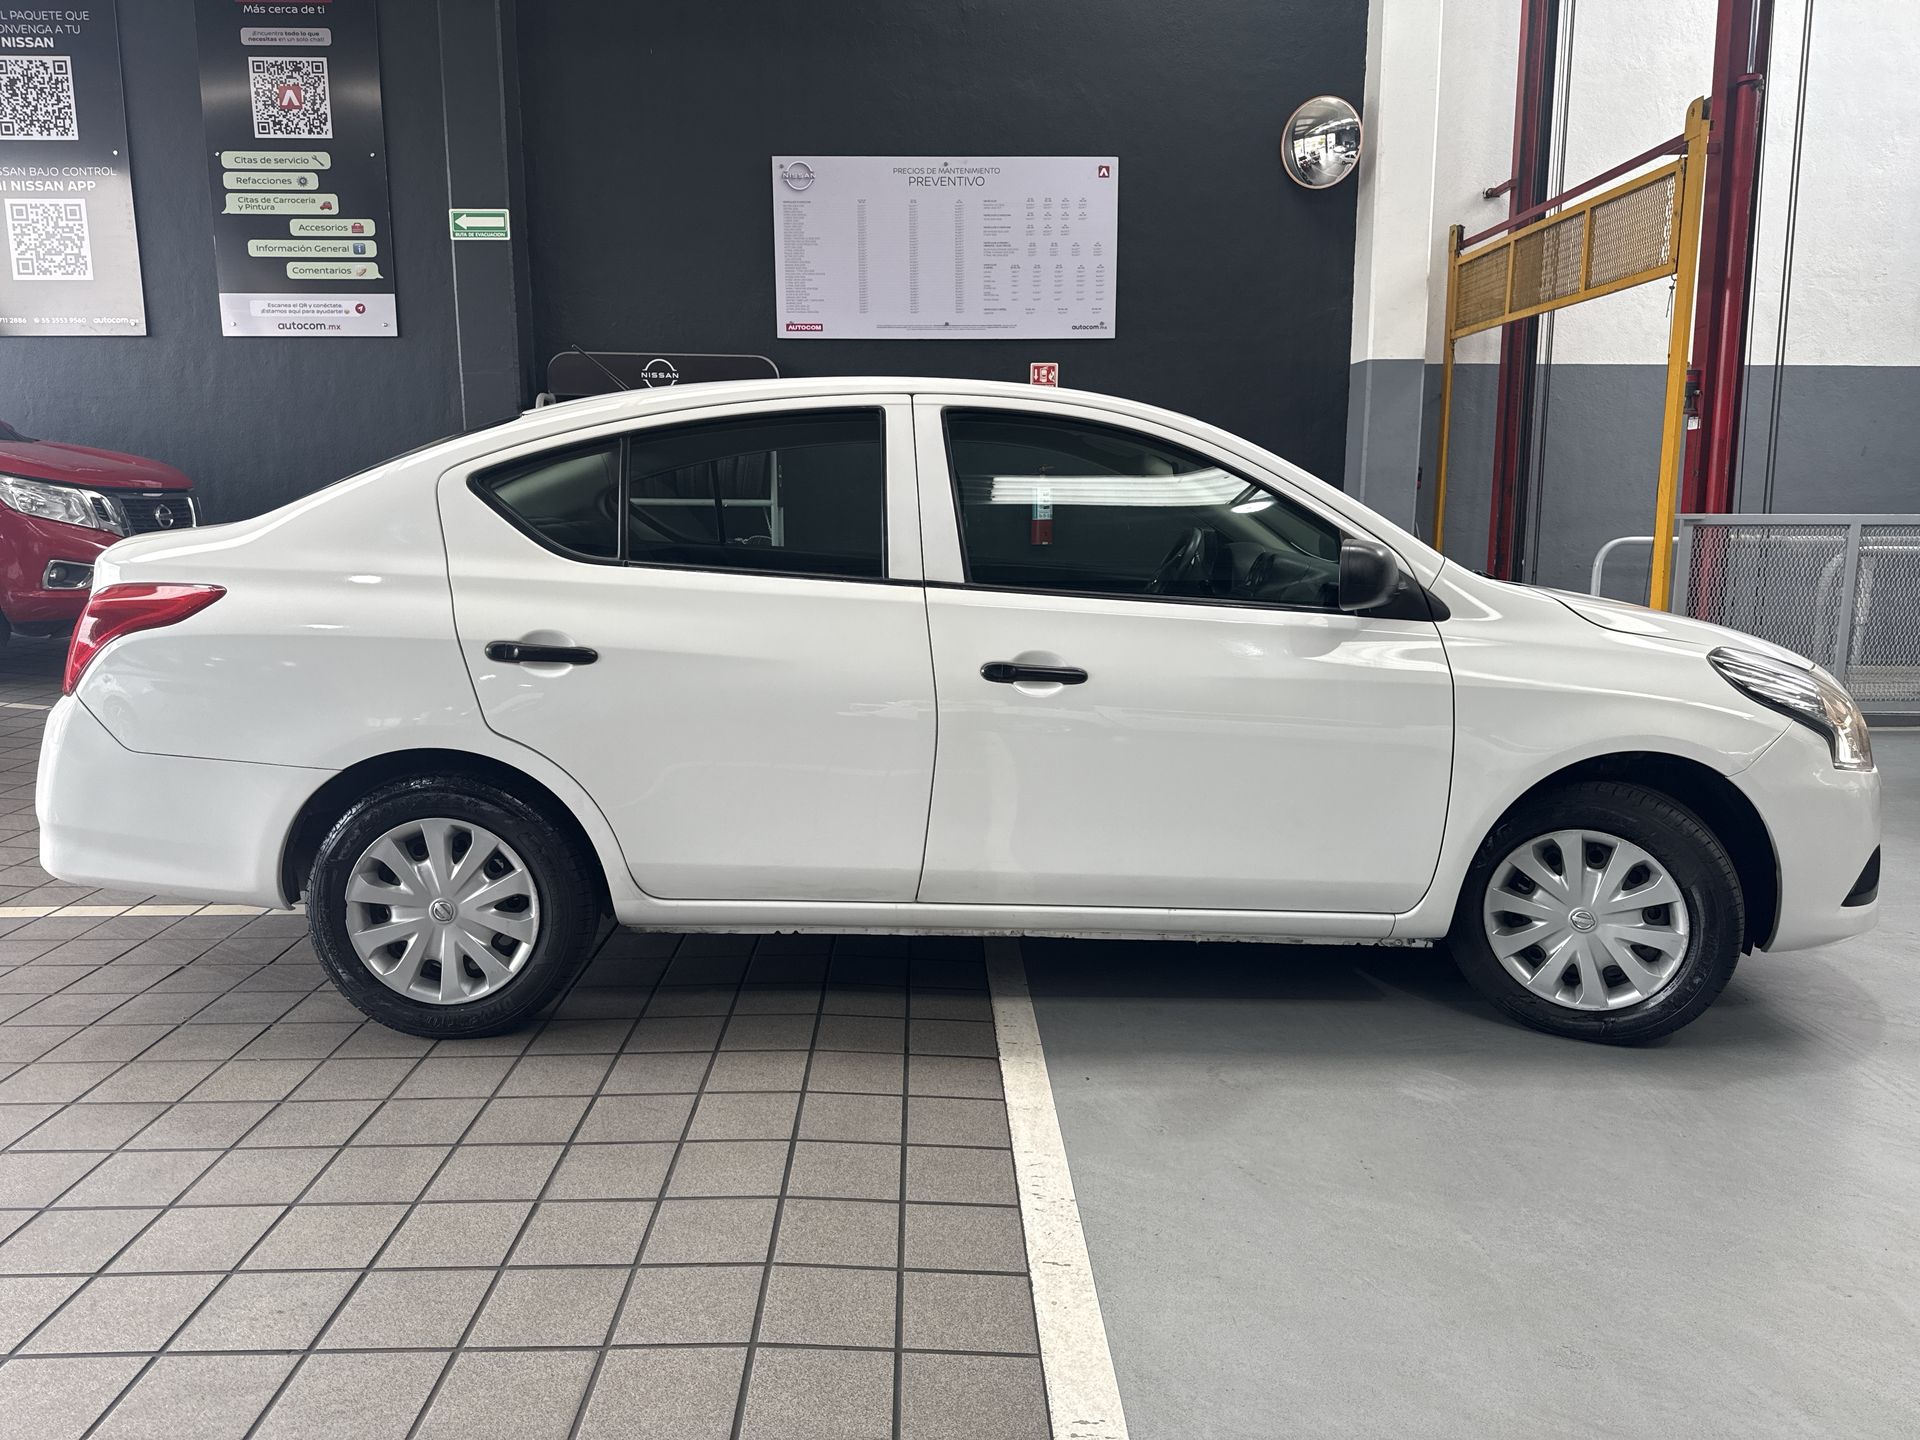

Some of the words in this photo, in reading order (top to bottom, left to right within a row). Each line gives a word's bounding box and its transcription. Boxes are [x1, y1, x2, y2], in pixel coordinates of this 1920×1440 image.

[243, 4, 266, 14] Más
[268, 6, 298, 14] cerca
[301, 5, 315, 14] de
[317, 5, 325, 14] ti
[10, 10, 62, 21] PAQUETE
[65, 10, 90, 21] QUE
[55, 24, 63, 34] A
[65, 24, 80, 34] TU
[1, 36, 54, 48] NISSAN
[234, 156, 258, 165] Citas
[260, 156, 272, 165] de
[273, 156, 309, 165] servicio
[29, 166, 59, 177] BAJO
[62, 166, 117, 177] CONTROL
[892, 167, 925, 175] PRECIOS
[926, 167, 937, 175] DE
[938, 167, 1001, 175] MANTENIMIENTO
[236, 176, 292, 185] Refacciones
[908, 176, 986, 187] PREVENTIVO
[11, 180, 64, 192] NISSAN
[68, 180, 96, 192] APP
[238, 196, 259, 204] Citas
[260, 196, 271, 204] de
[298, 224, 348, 232] Accesorios
[256, 244, 312, 253] Información
[314, 245, 350, 253] General
[292, 266, 352, 275] Comentarios
[277, 321, 341, 330] autocom.mx
[641, 371, 679, 379] NISSAN
